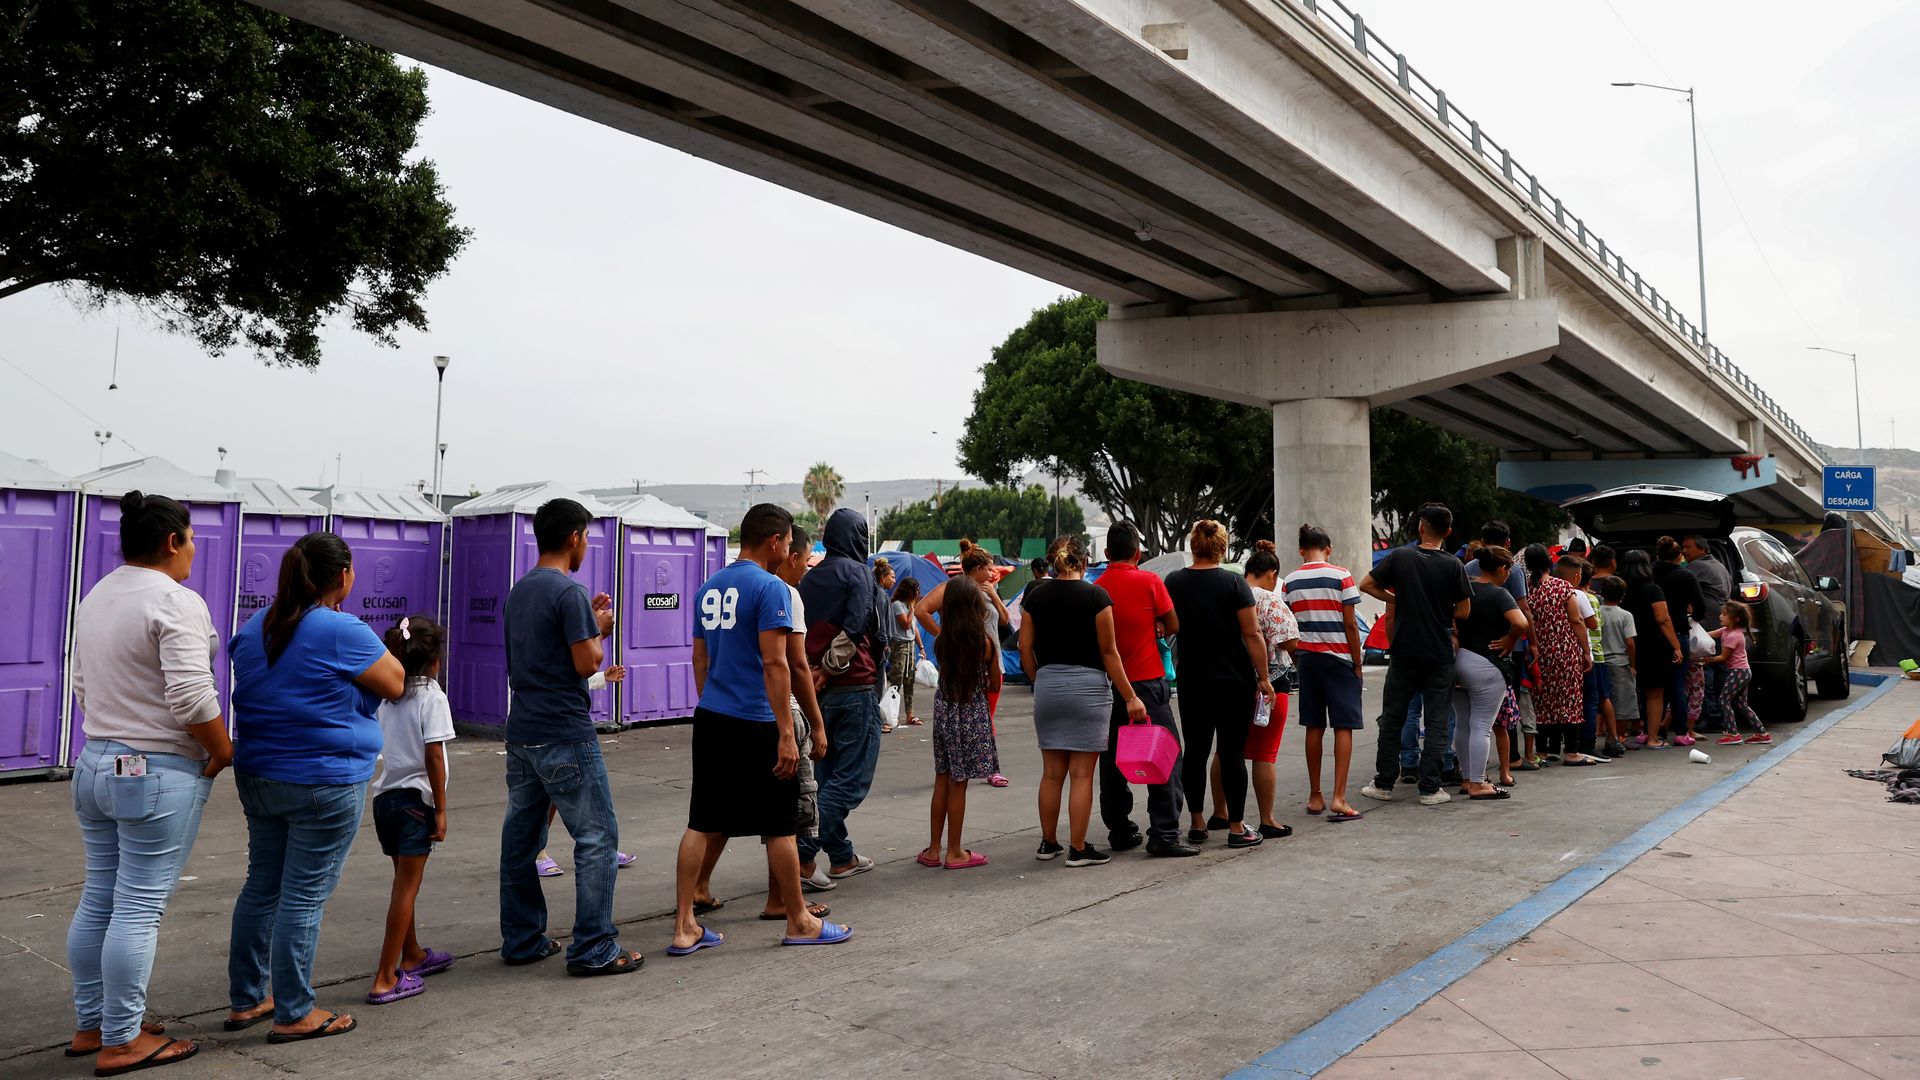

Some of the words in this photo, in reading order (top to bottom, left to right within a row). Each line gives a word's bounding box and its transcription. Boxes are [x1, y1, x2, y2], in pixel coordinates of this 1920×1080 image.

[1835, 471, 1862, 479] CARGA
[1846, 484, 1852, 492] Y
[1827, 497, 1869, 506] DESCARGA
[363, 596, 407, 611] ecosan
[647, 595, 675, 608] ecosan
[701, 587, 740, 631] 99
